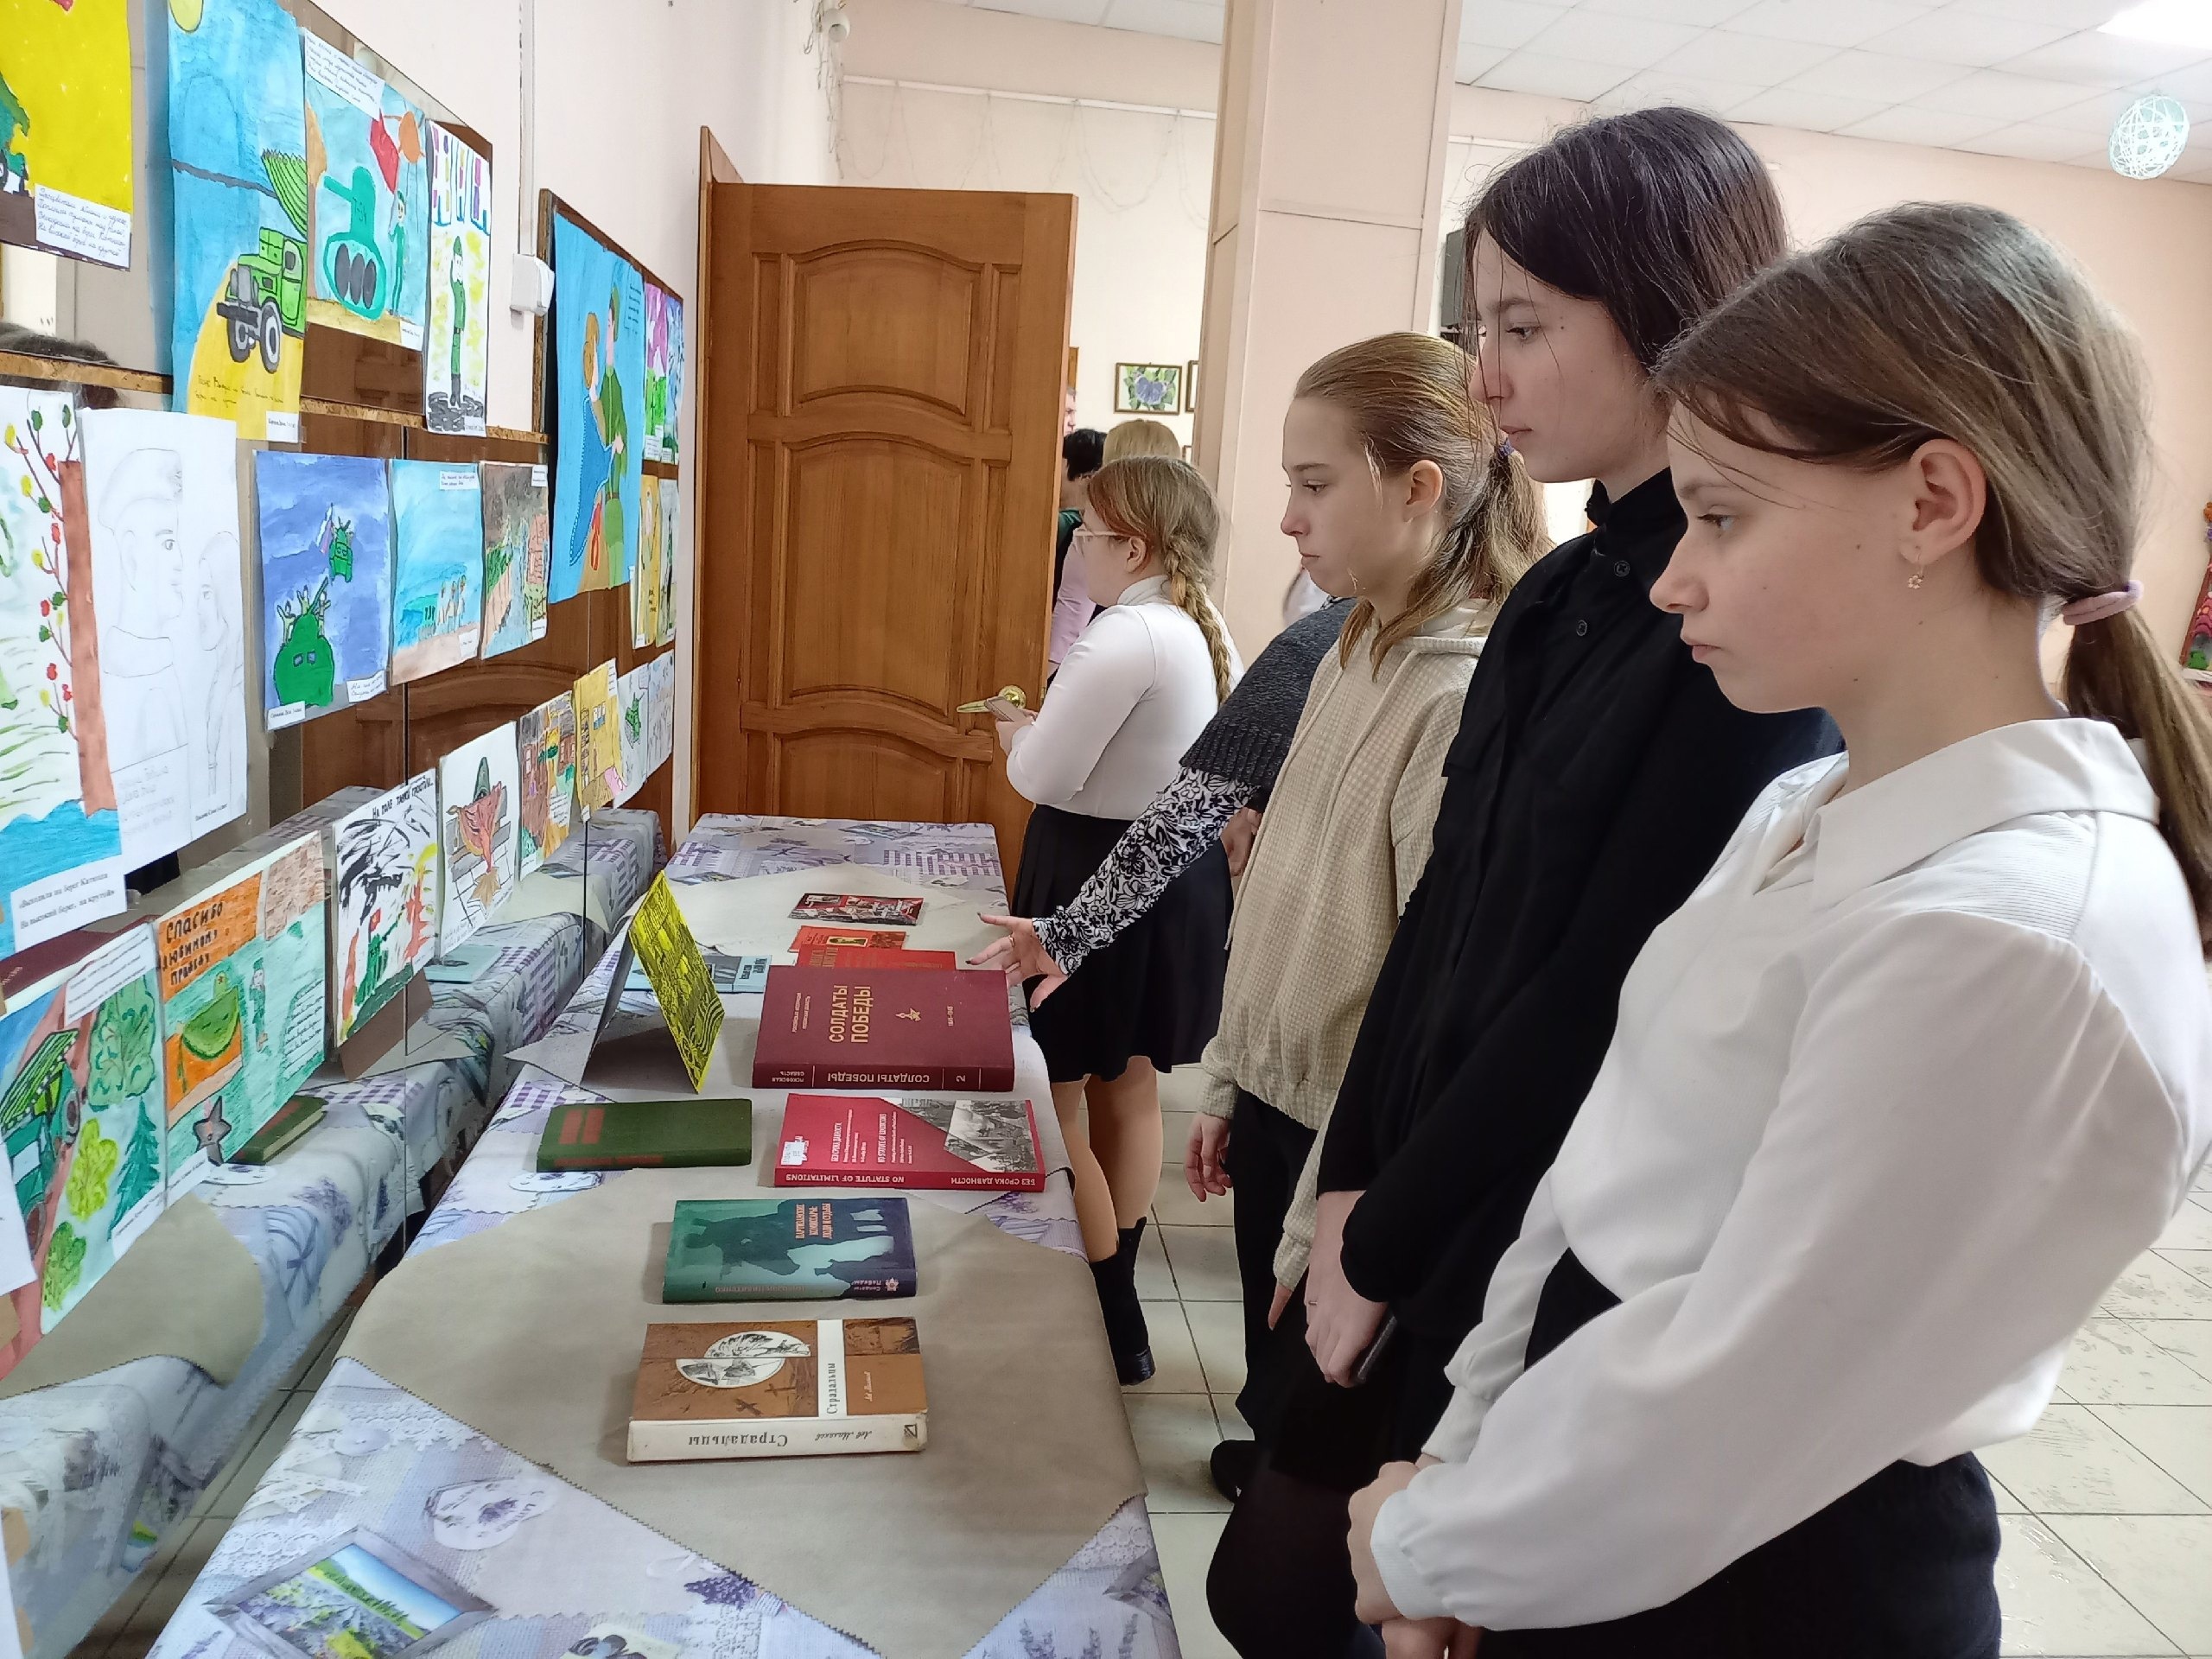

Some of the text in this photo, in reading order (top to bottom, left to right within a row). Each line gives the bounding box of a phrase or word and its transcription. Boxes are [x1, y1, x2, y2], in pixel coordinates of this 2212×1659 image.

[166, 902, 223, 944] СПАСИБО
[829, 985, 849, 1043] СОЛДАТЫ
[850, 986, 874, 1043] ПОБЕДЫ
[828, 1072, 930, 1083] СОЛДАТЫ ПОБЕДЫ
[785, 1173, 839, 1182] LIMITATIONS
[950, 1176, 993, 1185] ДАВНОСТИ
[827, 1363, 840, 1414] Страдальцы
[688, 1432, 788, 1447] Страдальцы
